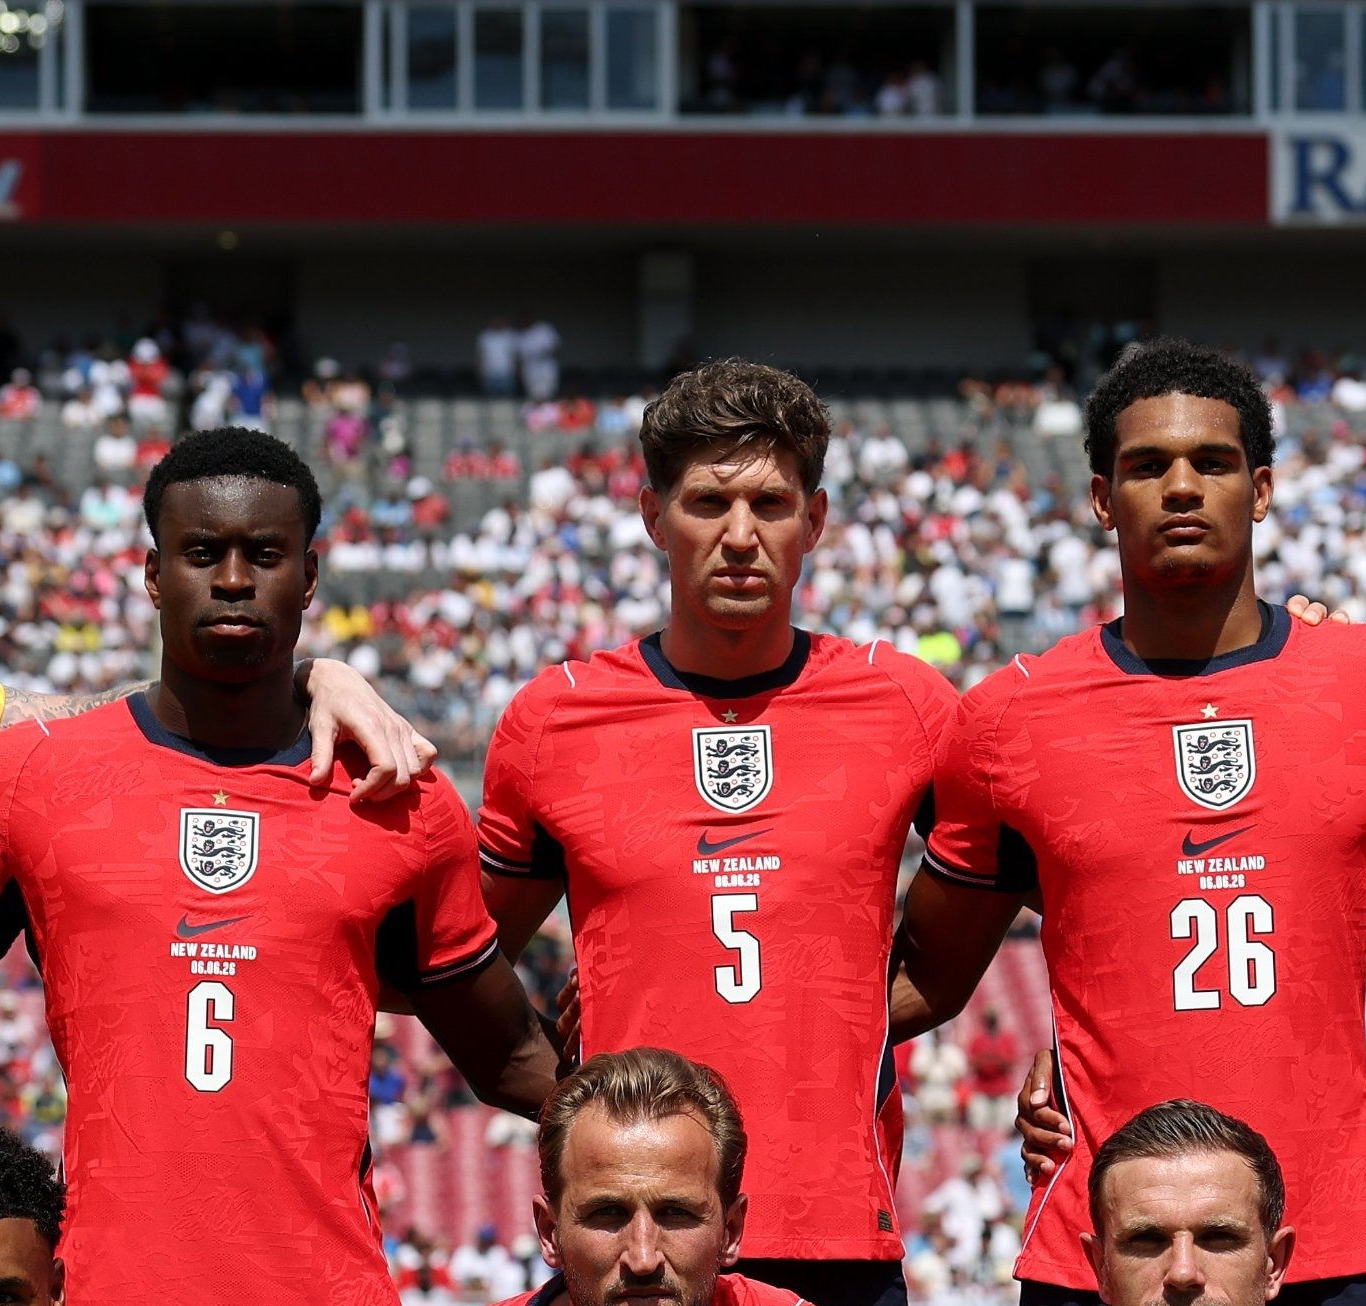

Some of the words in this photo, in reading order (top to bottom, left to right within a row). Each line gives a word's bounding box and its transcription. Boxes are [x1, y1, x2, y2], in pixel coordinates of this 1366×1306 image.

[693, 858, 721, 873] NEW
[723, 856, 780, 871] ZEALAND
[1177, 860, 1206, 874] NEW
[1208, 856, 1265, 872] ZEALAND
[715, 874, 760, 887] 06.06.26
[1199, 874, 1245, 889] 06.06.26
[170, 942, 198, 957] NEW
[200, 943, 257, 960] ZEALAND
[711, 893, 762, 1004] 5
[1170, 894, 1277, 1012] 26
[191, 961, 236, 975] 06.06.26
[185, 980, 234, 1092] 6
